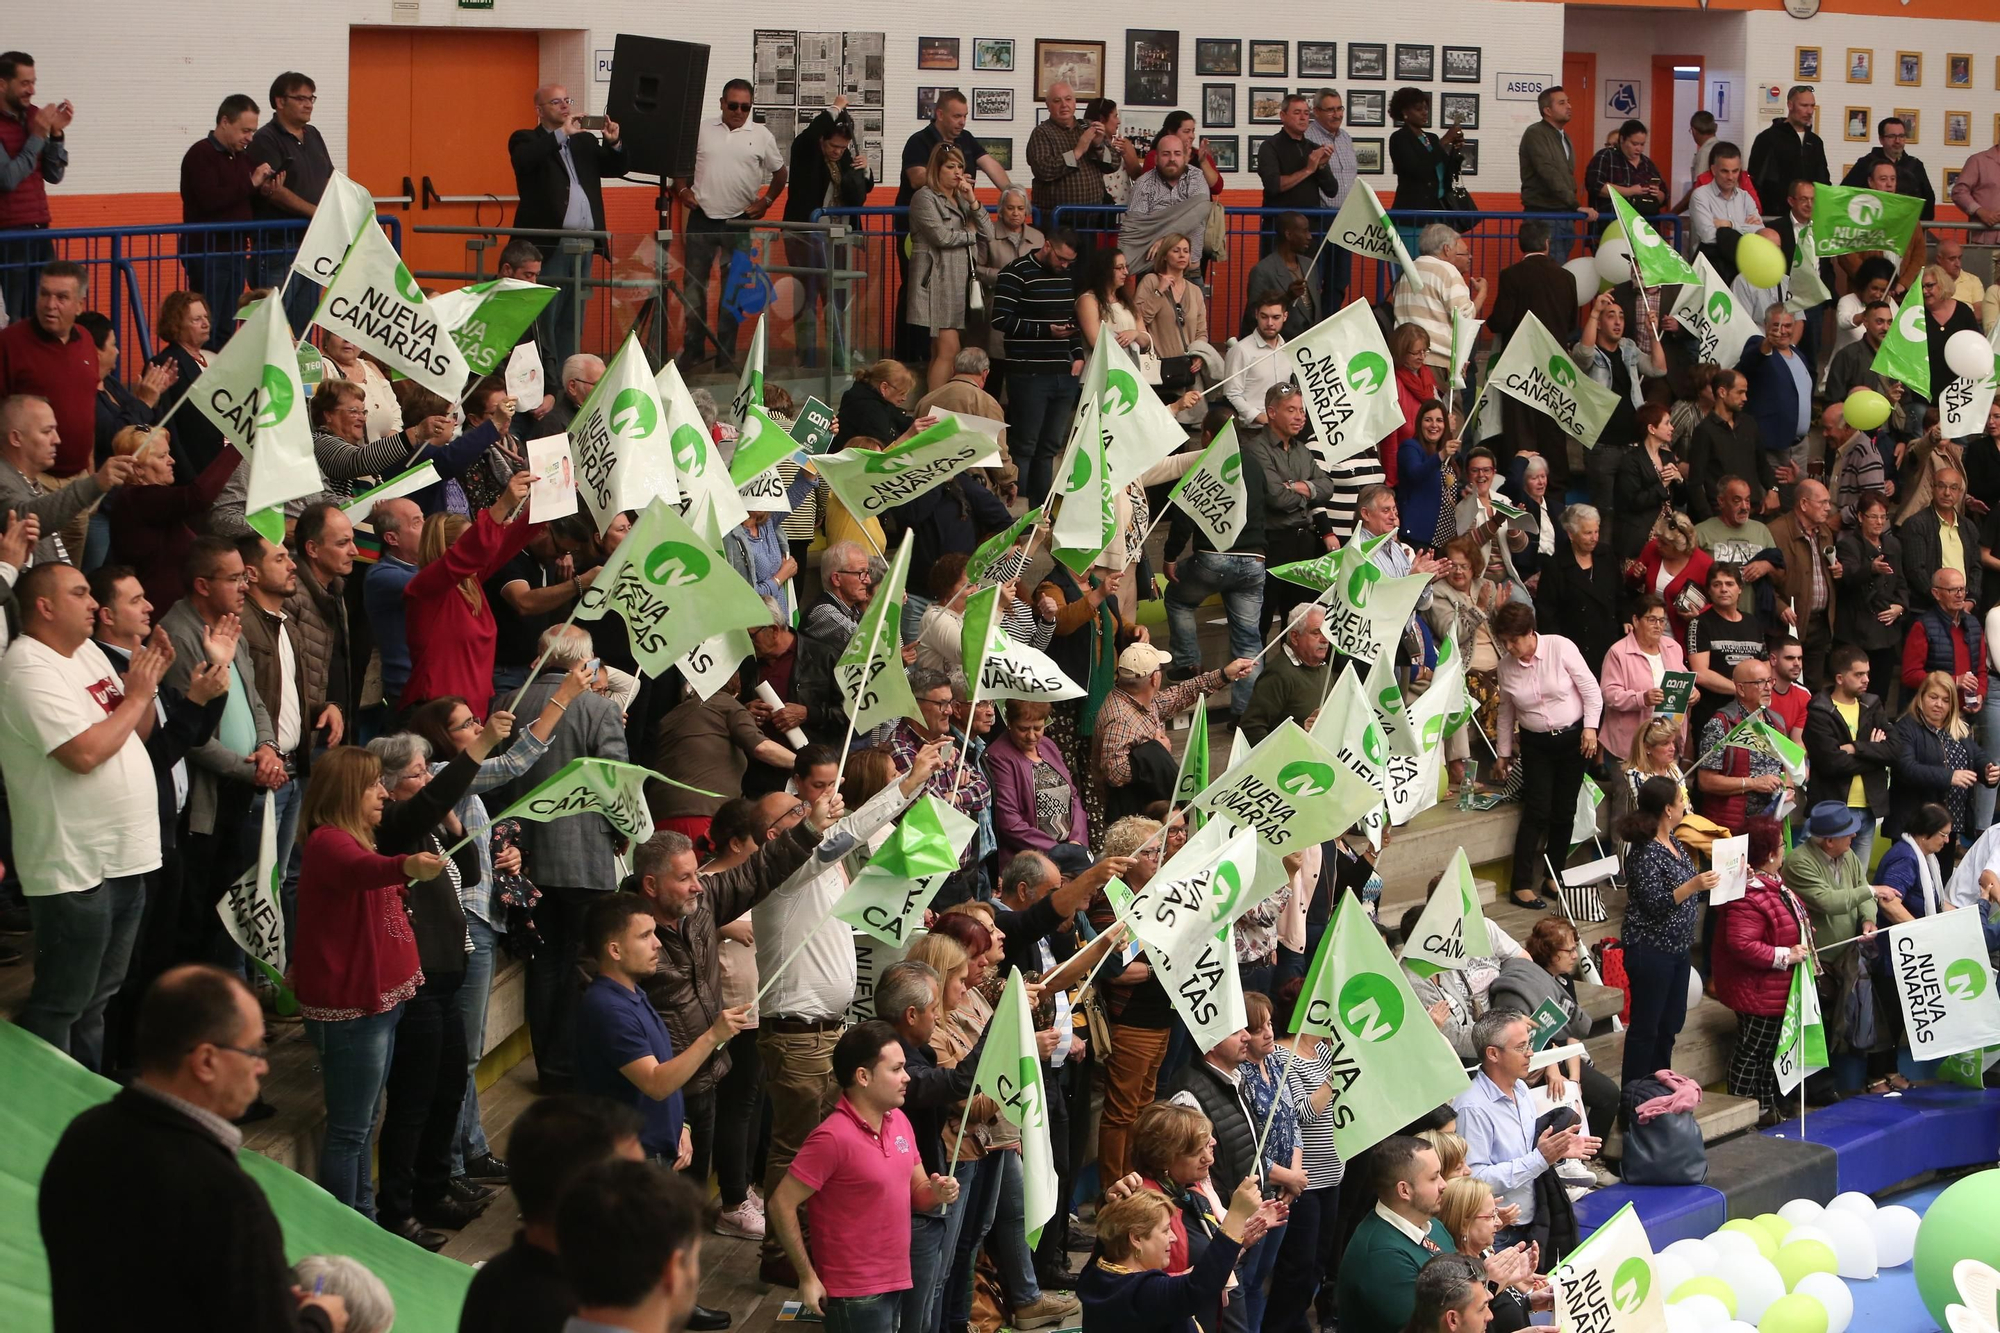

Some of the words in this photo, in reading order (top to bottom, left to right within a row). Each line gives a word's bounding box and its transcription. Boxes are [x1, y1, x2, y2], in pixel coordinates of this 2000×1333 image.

[1507, 82, 1542, 93] ASEOS
[1841, 226, 1886, 240] NUEVA
[329, 296, 451, 377] CANARIAS
[359, 286, 438, 346] NUEVA
[1295, 346, 1345, 446] CANARIAS
[1317, 354, 1354, 424] NUEVA
[1505, 373, 1585, 436] CANARIAS
[1528, 366, 1578, 417] NUEVA
[1945, 382, 1971, 424] RIAS
[576, 427, 612, 511] ANARIAS
[588, 406, 618, 478] NUEVA
[862, 444, 976, 510] CANARIAS
[870, 457, 950, 495] NUEVA
[1193, 467, 1236, 514] NUEVA
[1181, 482, 1232, 535] ANARIAS
[981, 668, 1063, 694] NARIAS
[1235, 774, 1296, 825] NUEVA
[1898, 937, 1934, 1044] CANARIAS
[1917, 953, 1947, 1023] NUEVA
[1581, 1268, 1616, 1333] NUEV
